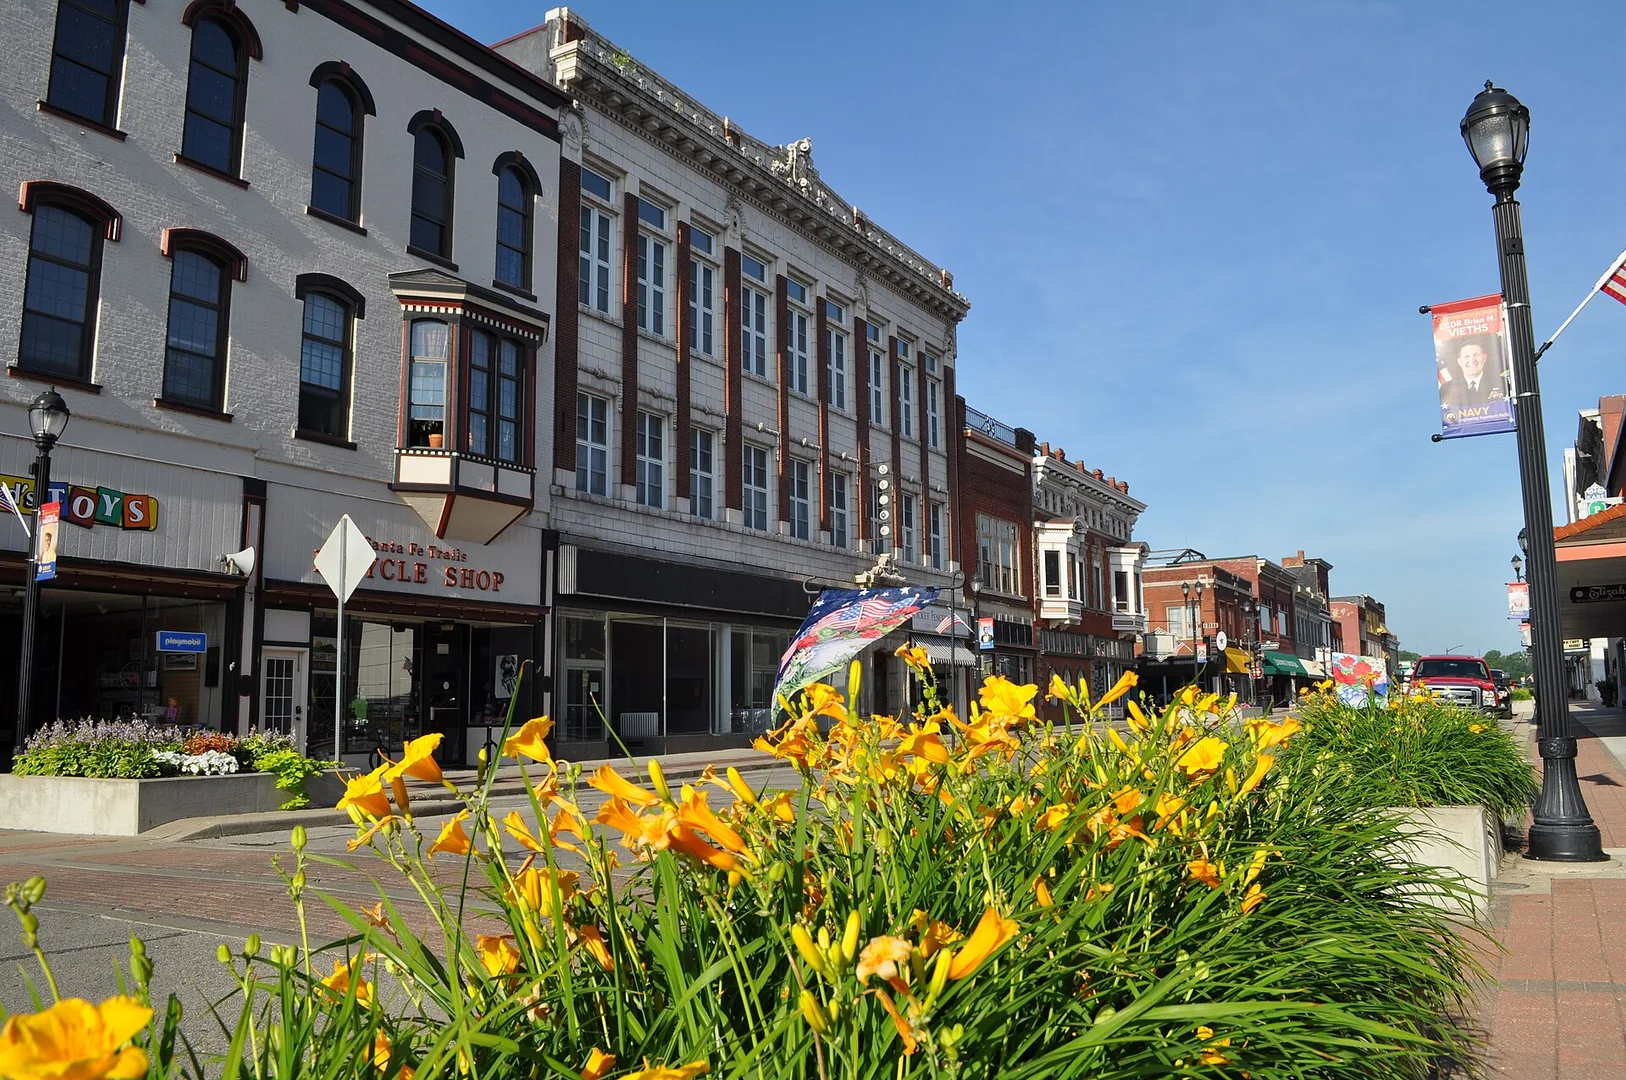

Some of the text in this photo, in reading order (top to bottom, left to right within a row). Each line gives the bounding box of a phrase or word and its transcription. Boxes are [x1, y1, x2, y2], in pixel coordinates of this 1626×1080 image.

[1448, 323, 1489, 337] VIETHS
[1458, 406, 1490, 418] NAVY
[8, 483, 35, 507] d's
[409, 541, 425, 557] Fe
[427, 544, 468, 563] Trails
[443, 566, 506, 592] SHOP
[1588, 585, 1626, 599] Elizab
[164, 637, 202, 647] playmobil
